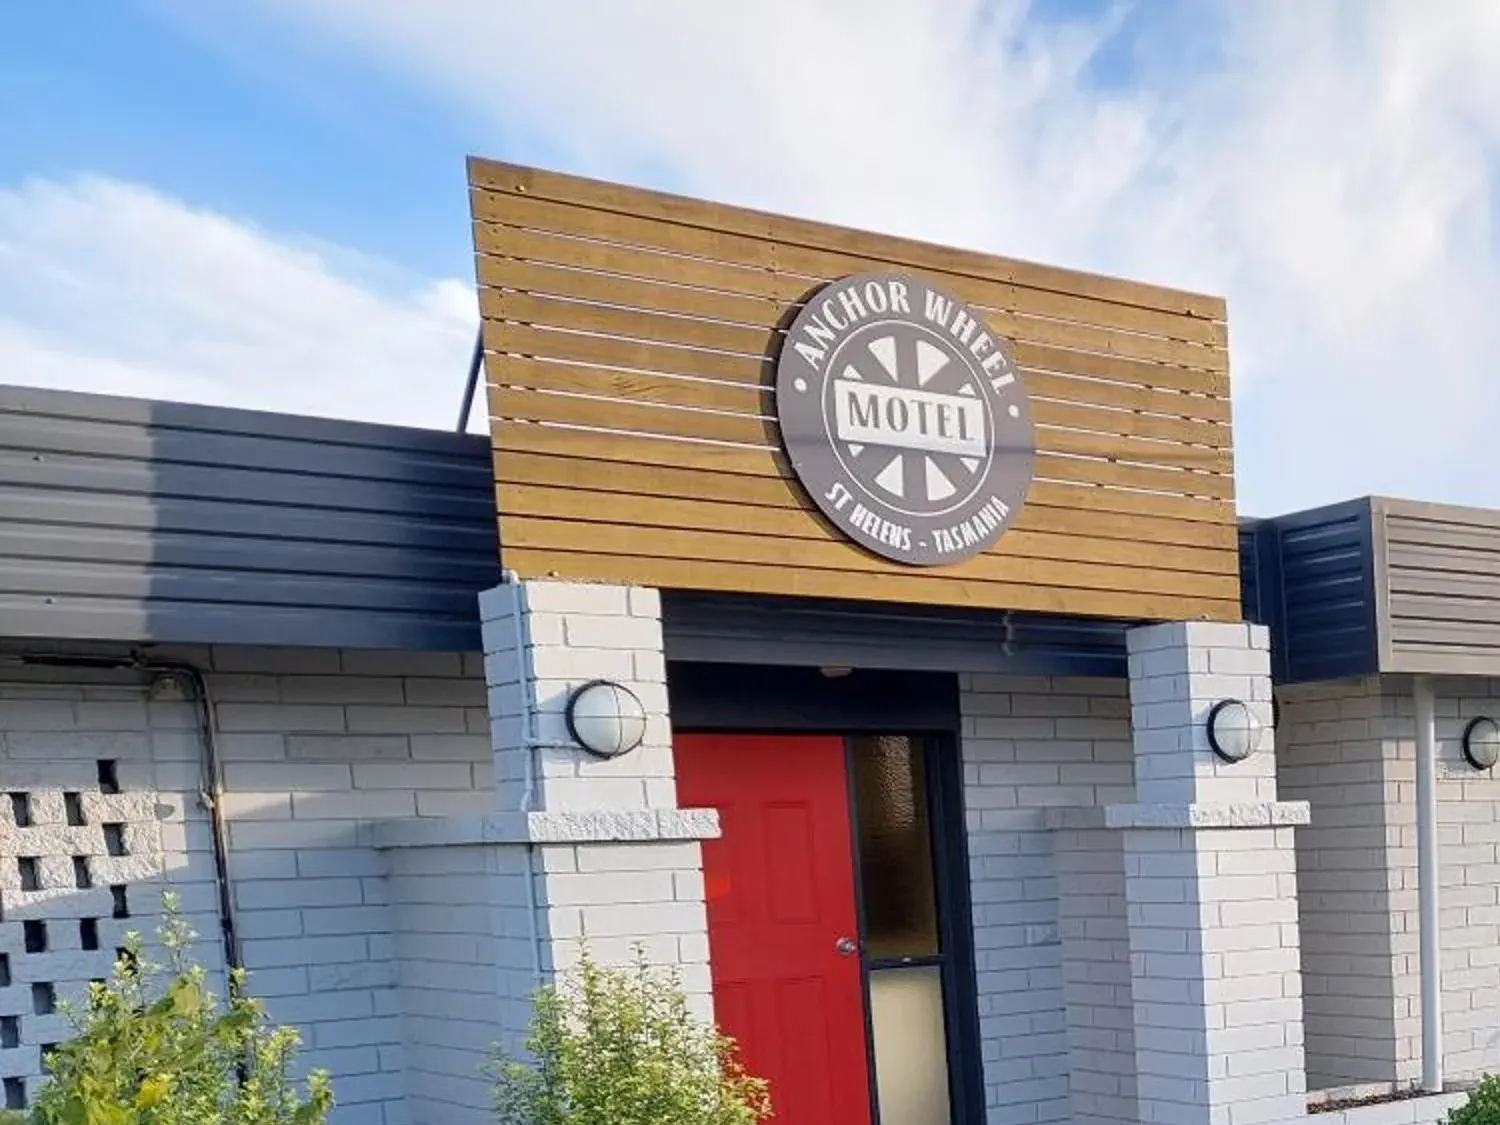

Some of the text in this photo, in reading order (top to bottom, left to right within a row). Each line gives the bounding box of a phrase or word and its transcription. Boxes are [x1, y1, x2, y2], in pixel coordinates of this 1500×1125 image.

[794, 281, 1016, 394] ANCHOR WHEEL
[848, 391, 975, 441] MOTEL
[824, 482, 853, 510] ST
[849, 503, 912, 551] HELENS
[932, 495, 1010, 554] TASMANIA
